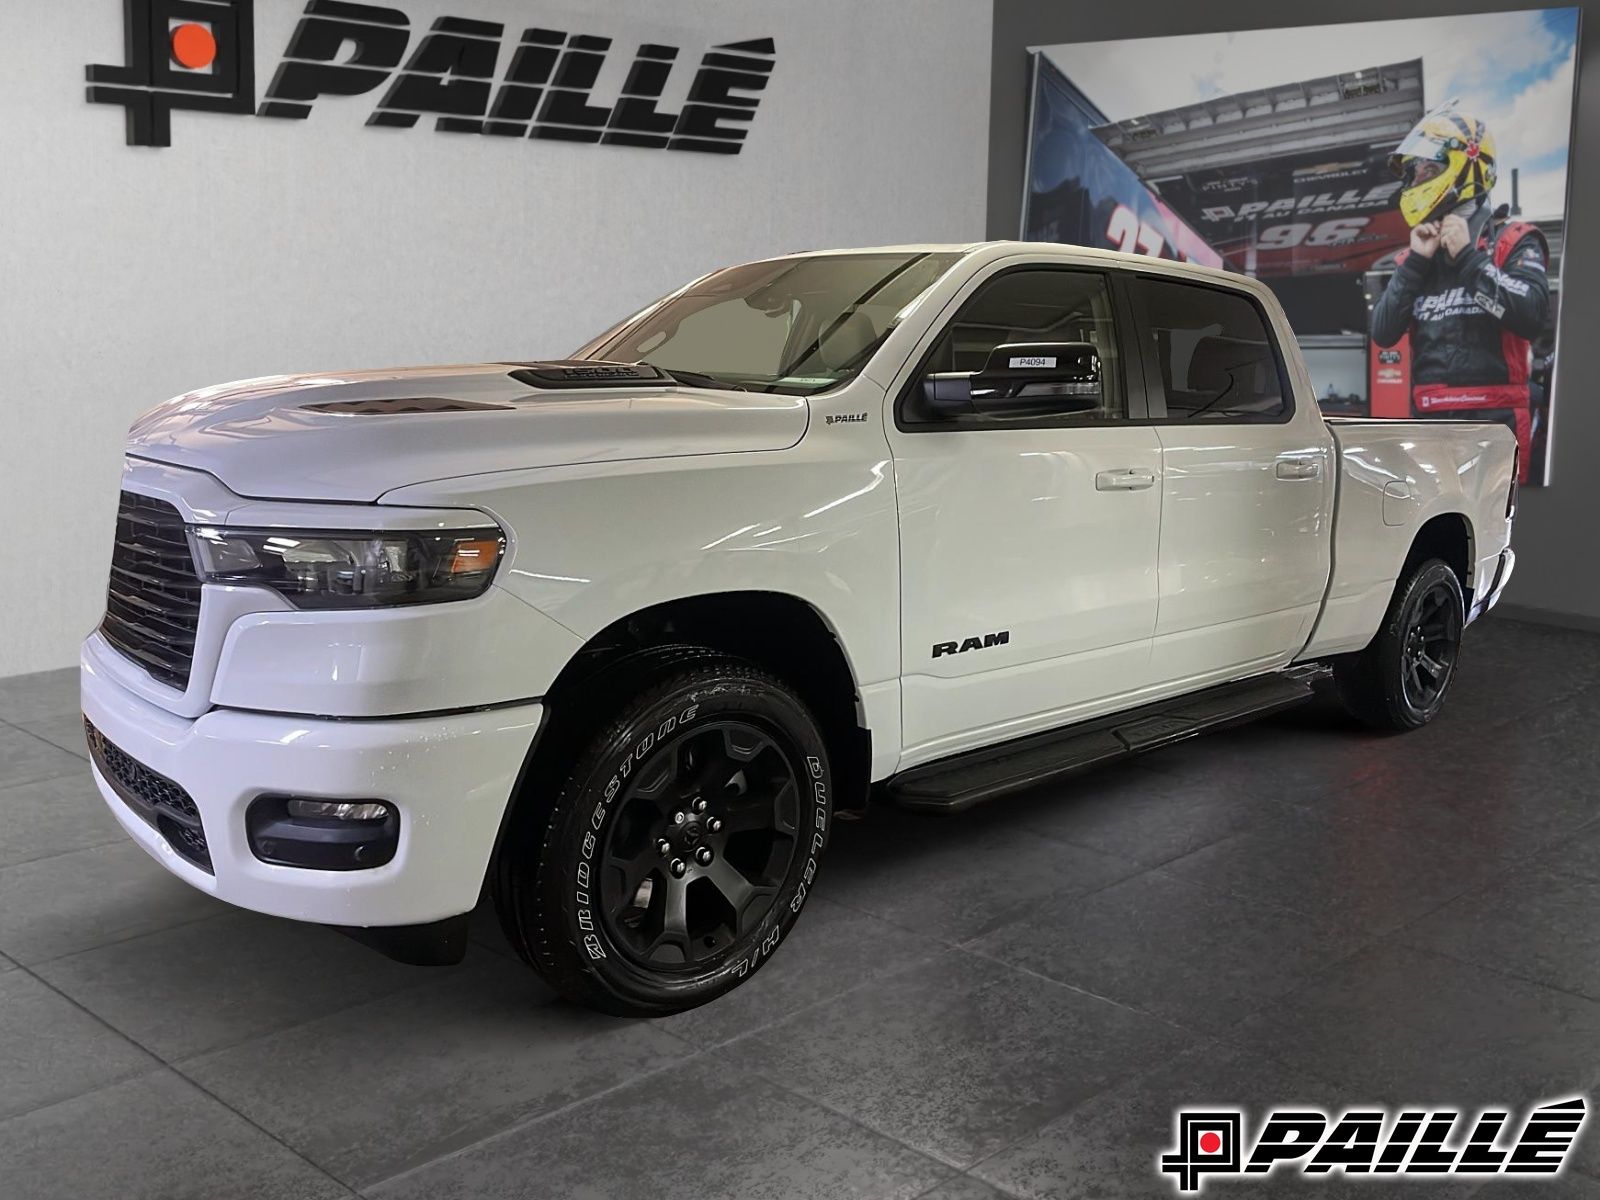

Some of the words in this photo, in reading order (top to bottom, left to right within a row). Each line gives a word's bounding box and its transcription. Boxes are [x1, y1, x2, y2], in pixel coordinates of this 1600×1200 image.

[256, 0, 777, 155] PAILLÉ
[1297, 200, 1389, 215] CANADA
[1256, 217, 1371, 250] 96
[1020, 358, 1046, 366] P4094
[931, 630, 1010, 659] RAM
[575, 703, 701, 961] BRIDGESTONE
[789, 755, 829, 914] DUELER
[731, 922, 781, 978] H/L
